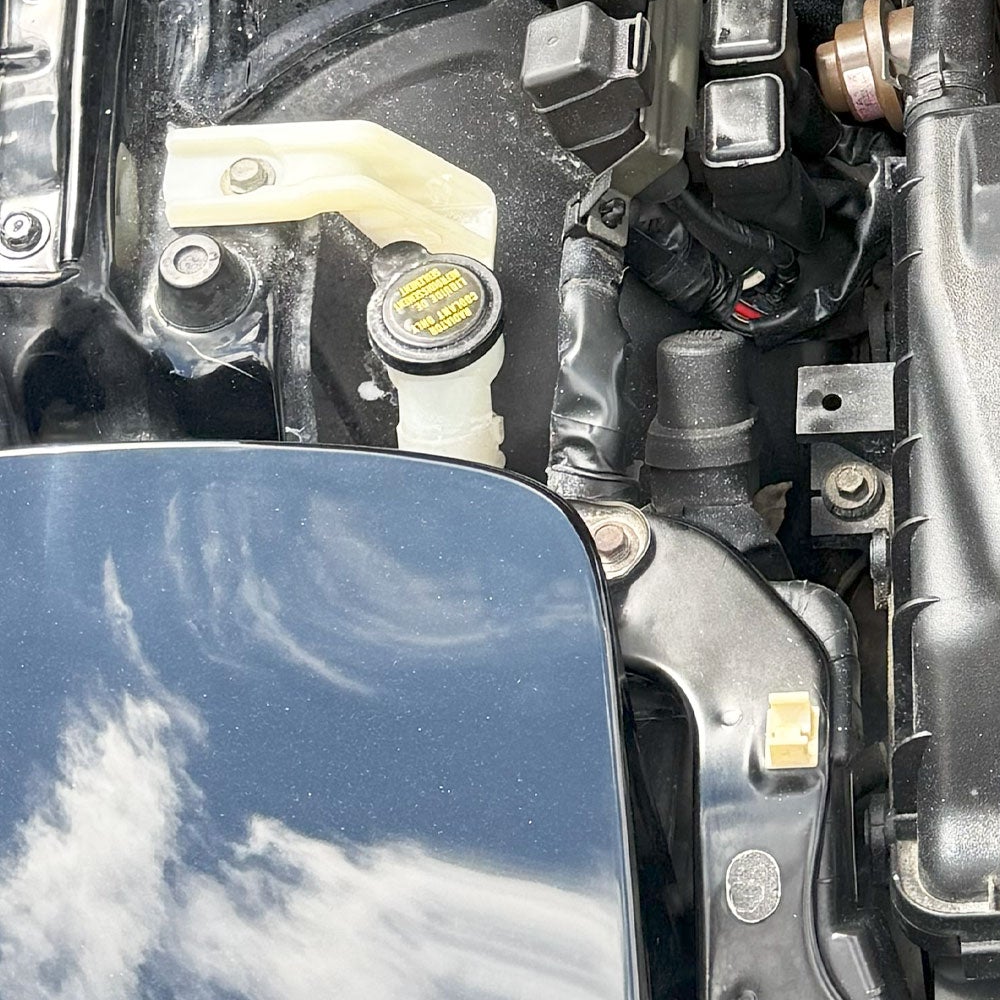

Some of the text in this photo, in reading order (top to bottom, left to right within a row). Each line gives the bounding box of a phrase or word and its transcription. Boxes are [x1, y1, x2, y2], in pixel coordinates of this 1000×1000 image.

[414, 276, 468, 312] LIQUIDE DE
[412, 291, 479, 335] COOLANT ONLY
[428, 306, 472, 336] RADIATOR
